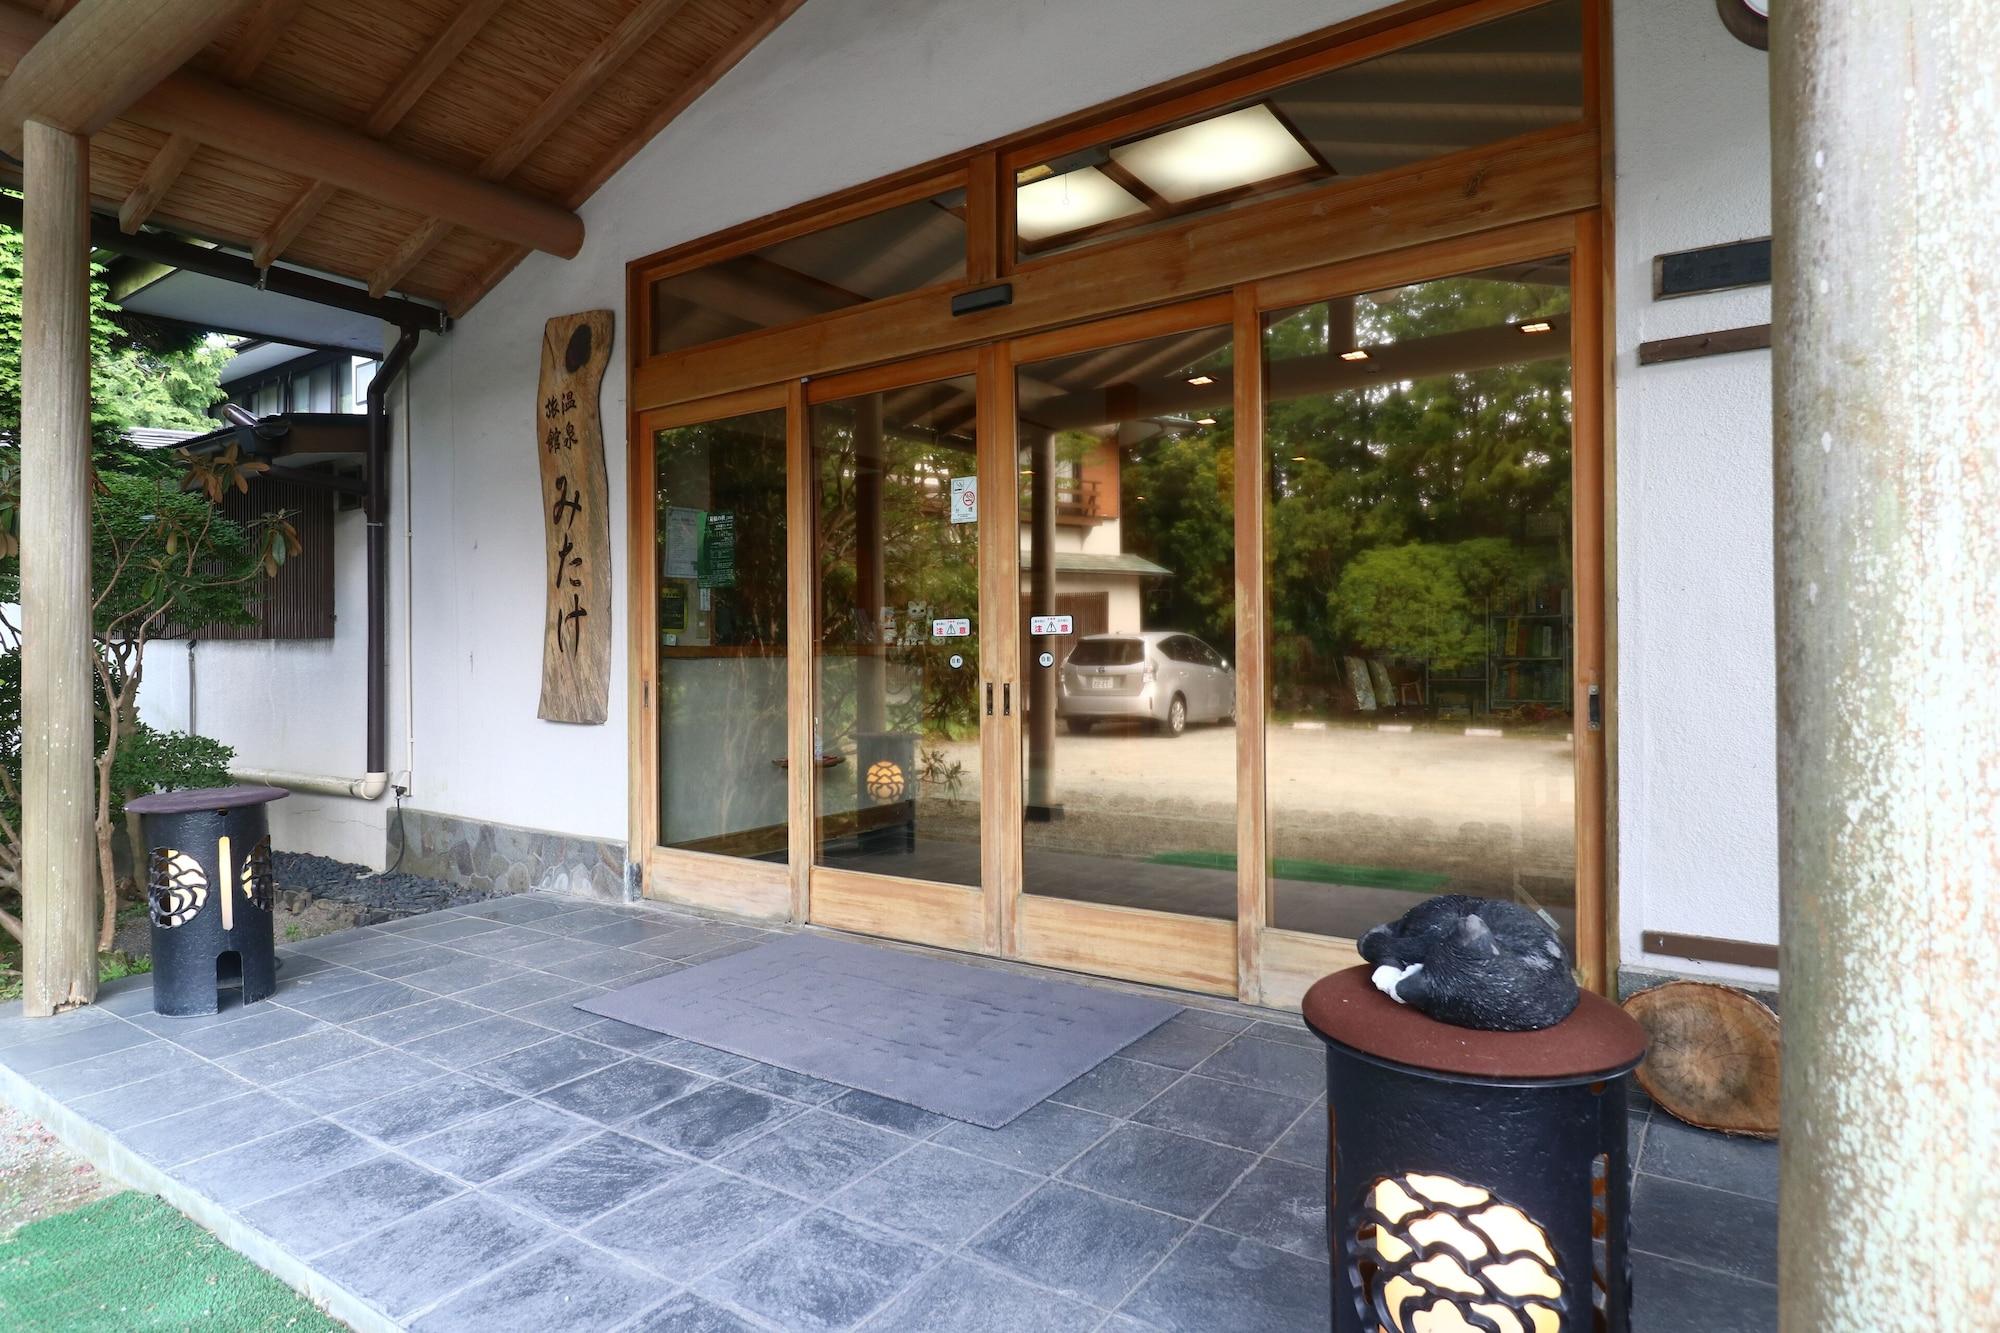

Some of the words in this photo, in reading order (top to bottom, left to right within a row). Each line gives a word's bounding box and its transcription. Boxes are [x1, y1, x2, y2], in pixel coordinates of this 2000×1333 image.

[561, 390, 578, 450] 温泉
[553, 475, 587, 660] みたけ
